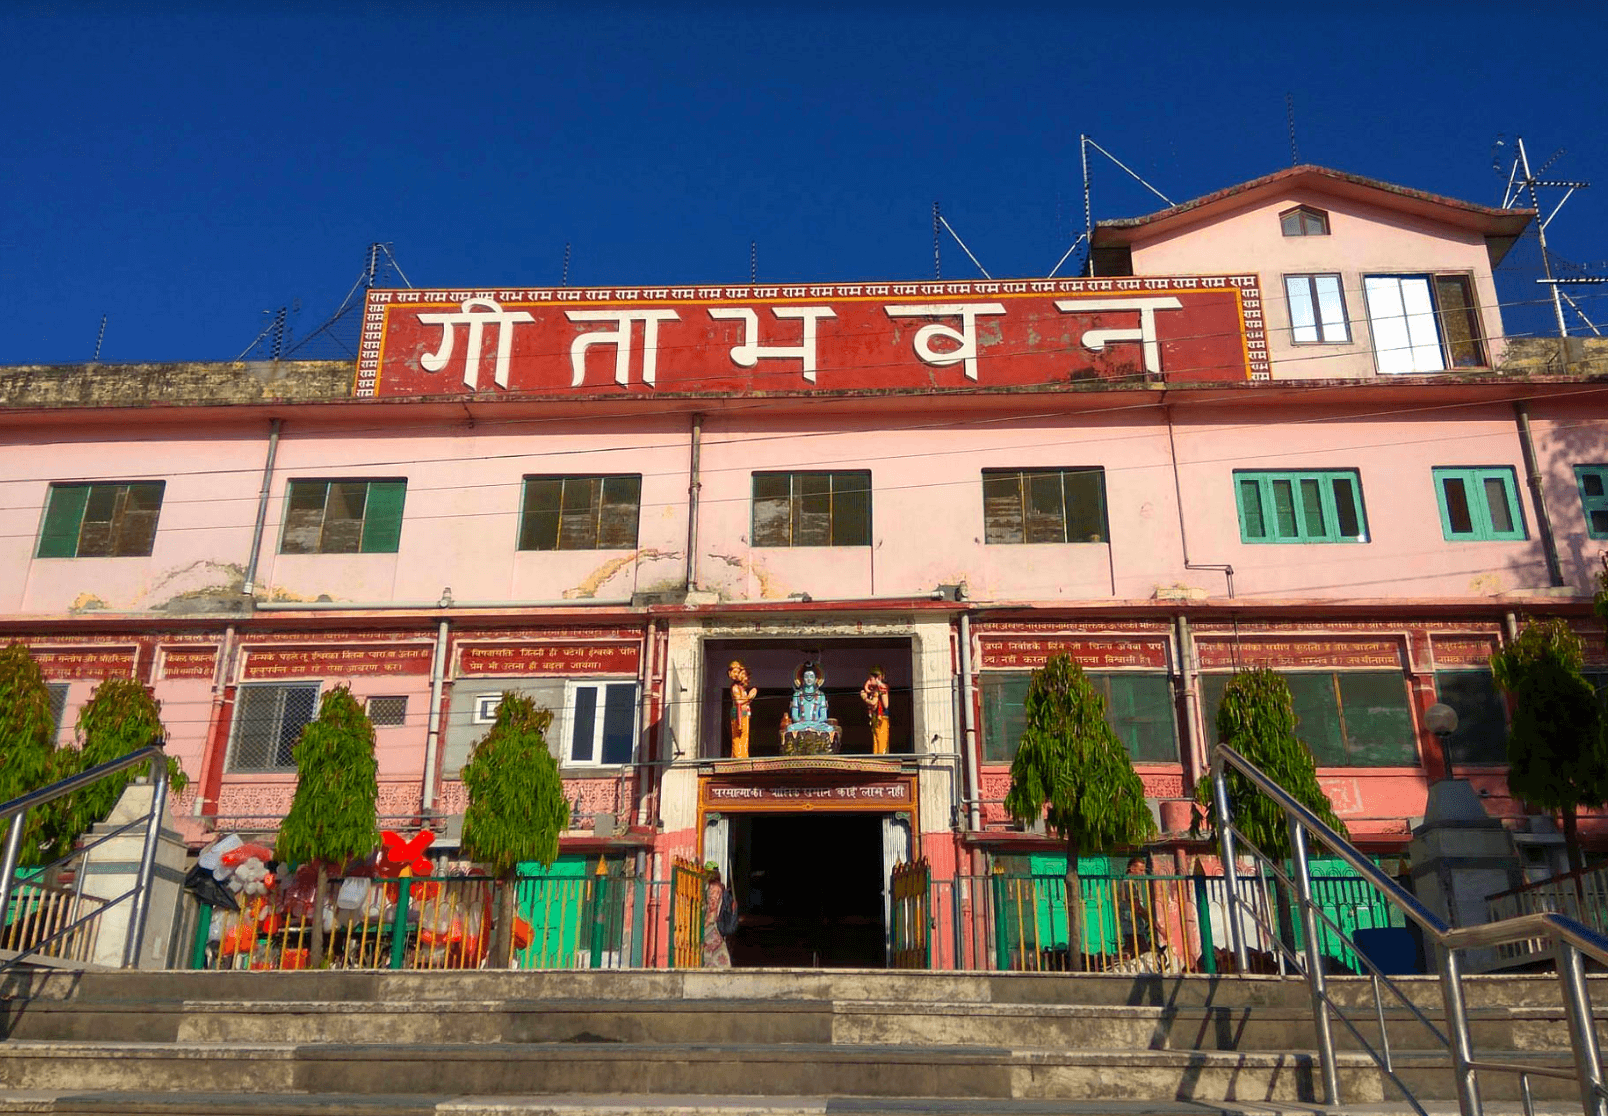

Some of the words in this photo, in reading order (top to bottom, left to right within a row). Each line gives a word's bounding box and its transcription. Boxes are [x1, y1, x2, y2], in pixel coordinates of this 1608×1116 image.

[368, 293, 392, 302] राम
[397, 291, 421, 301] राम
[424, 291, 448, 301] राम
[528, 290, 552, 300] राम
[557, 290, 582, 300] राम
[585, 289, 611, 299] राम
[616, 289, 640, 299] राम
[643, 289, 669, 299] राम
[672, 289, 695, 299] राम
[698, 288, 722, 298] राम
[726, 288, 750, 298] राम
[753, 287, 779, 297] राम
[783, 287, 807, 297] राम
[810, 286, 834, 296] राम
[837, 285, 862, 295] राम
[866, 285, 889, 295] राम
[893, 284, 918, 294] राम
[921, 284, 944, 294] राम
[947, 283, 971, 293] राम
[974, 283, 1000, 293] राम
[1003, 282, 1027, 292] राम
[1030, 281, 1056, 291] राम
[1060, 281, 1084, 291] राम
[1087, 281, 1113, 291] राम
[1116, 279, 1141, 289] राम
[1144, 279, 1170, 289] राम
[1172, 278, 1198, 288] राम
[1201, 277, 1226, 287] राम
[1229, 276, 1252, 286] राम
[1242, 289, 1259, 297] राम
[1243, 300, 1259, 308] राम
[1244, 310, 1260, 318] राम
[1245, 320, 1263, 328] राम
[365, 332, 382, 340] राम
[364, 341, 380, 349] राम
[417, 298, 681, 391] गीता
[708, 296, 1184, 382] भवन
[1248, 351, 1266, 359] राम
[361, 360, 377, 368] राम
[1250, 362, 1268, 370] राम
[1252, 372, 1269, 380] राम
[359, 379, 375, 388] राम
[357, 389, 374, 397] राम
